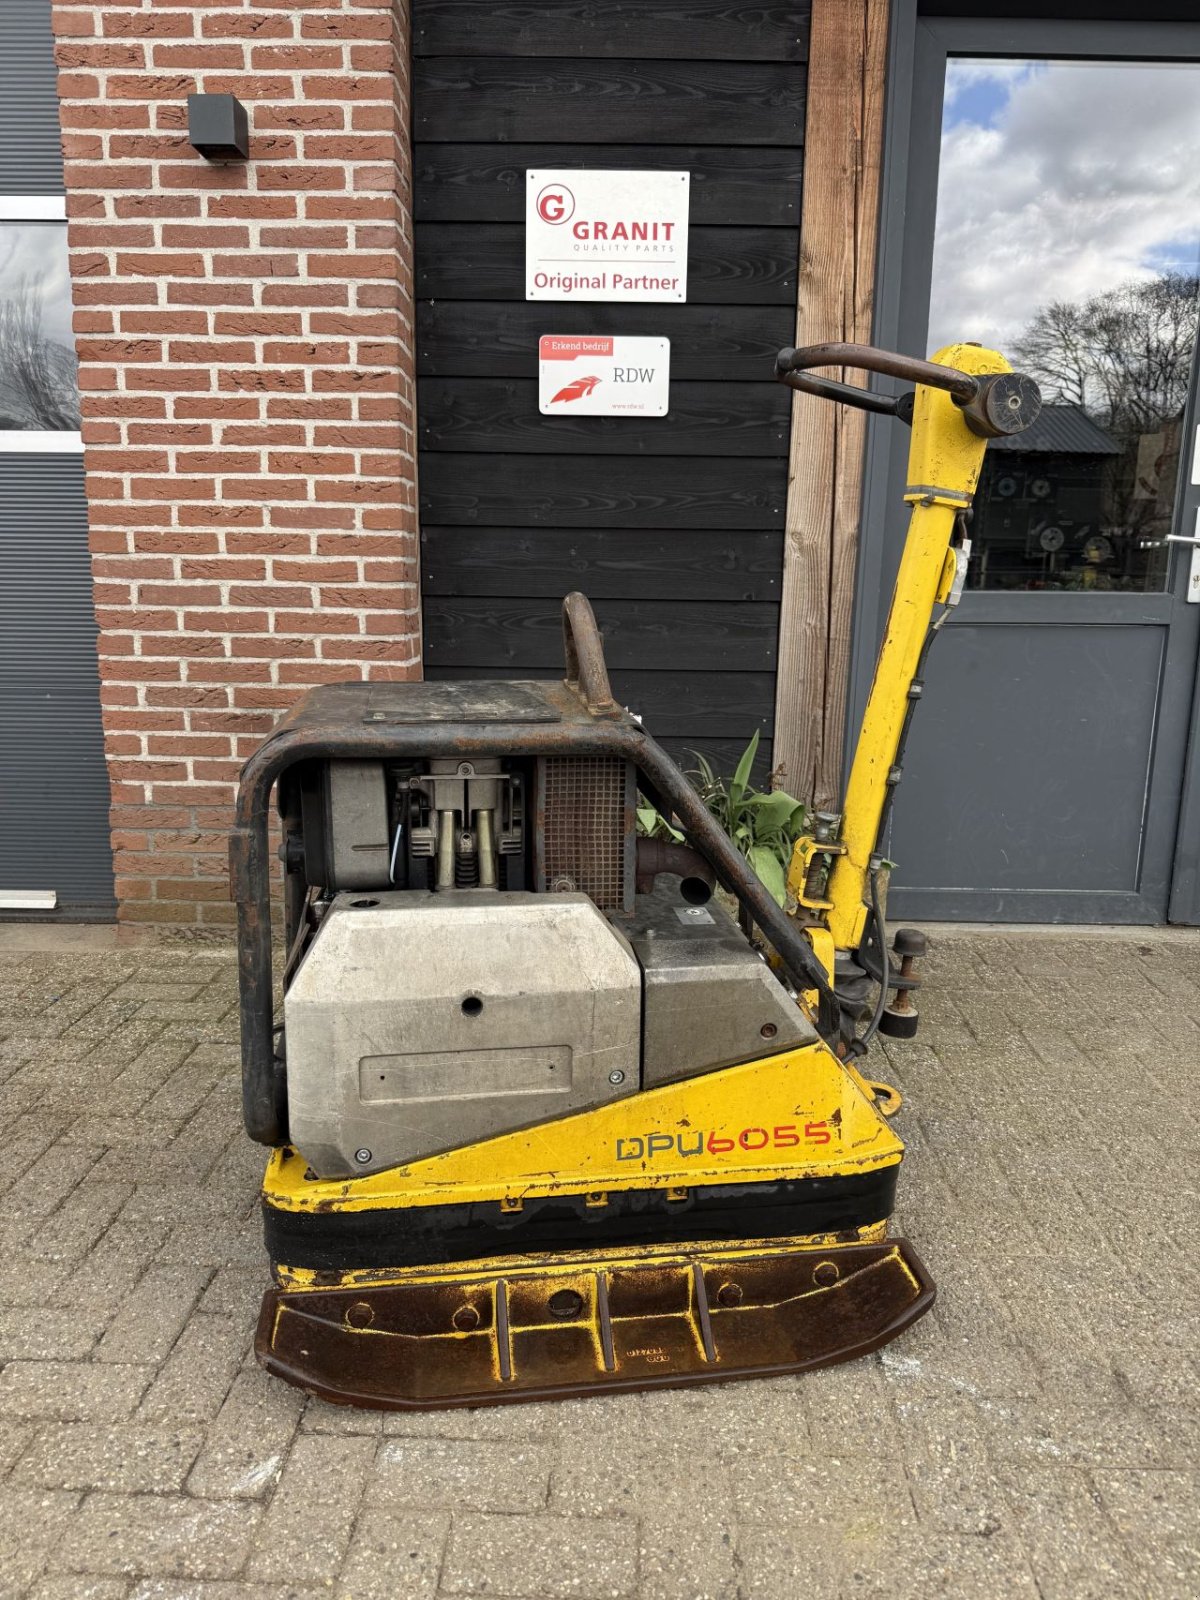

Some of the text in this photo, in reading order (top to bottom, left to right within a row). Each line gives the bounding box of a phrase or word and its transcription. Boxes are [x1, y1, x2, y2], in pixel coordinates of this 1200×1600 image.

[540, 195, 565, 221] G
[572, 221, 675, 241] GRANIT
[573, 244, 628, 252] QUALITY
[534, 272, 679, 293] Original Partner
[552, 341, 609, 352] Erkend bedrijf
[613, 367, 656, 383] RDW
[616, 1123, 831, 1161] DPU6055
